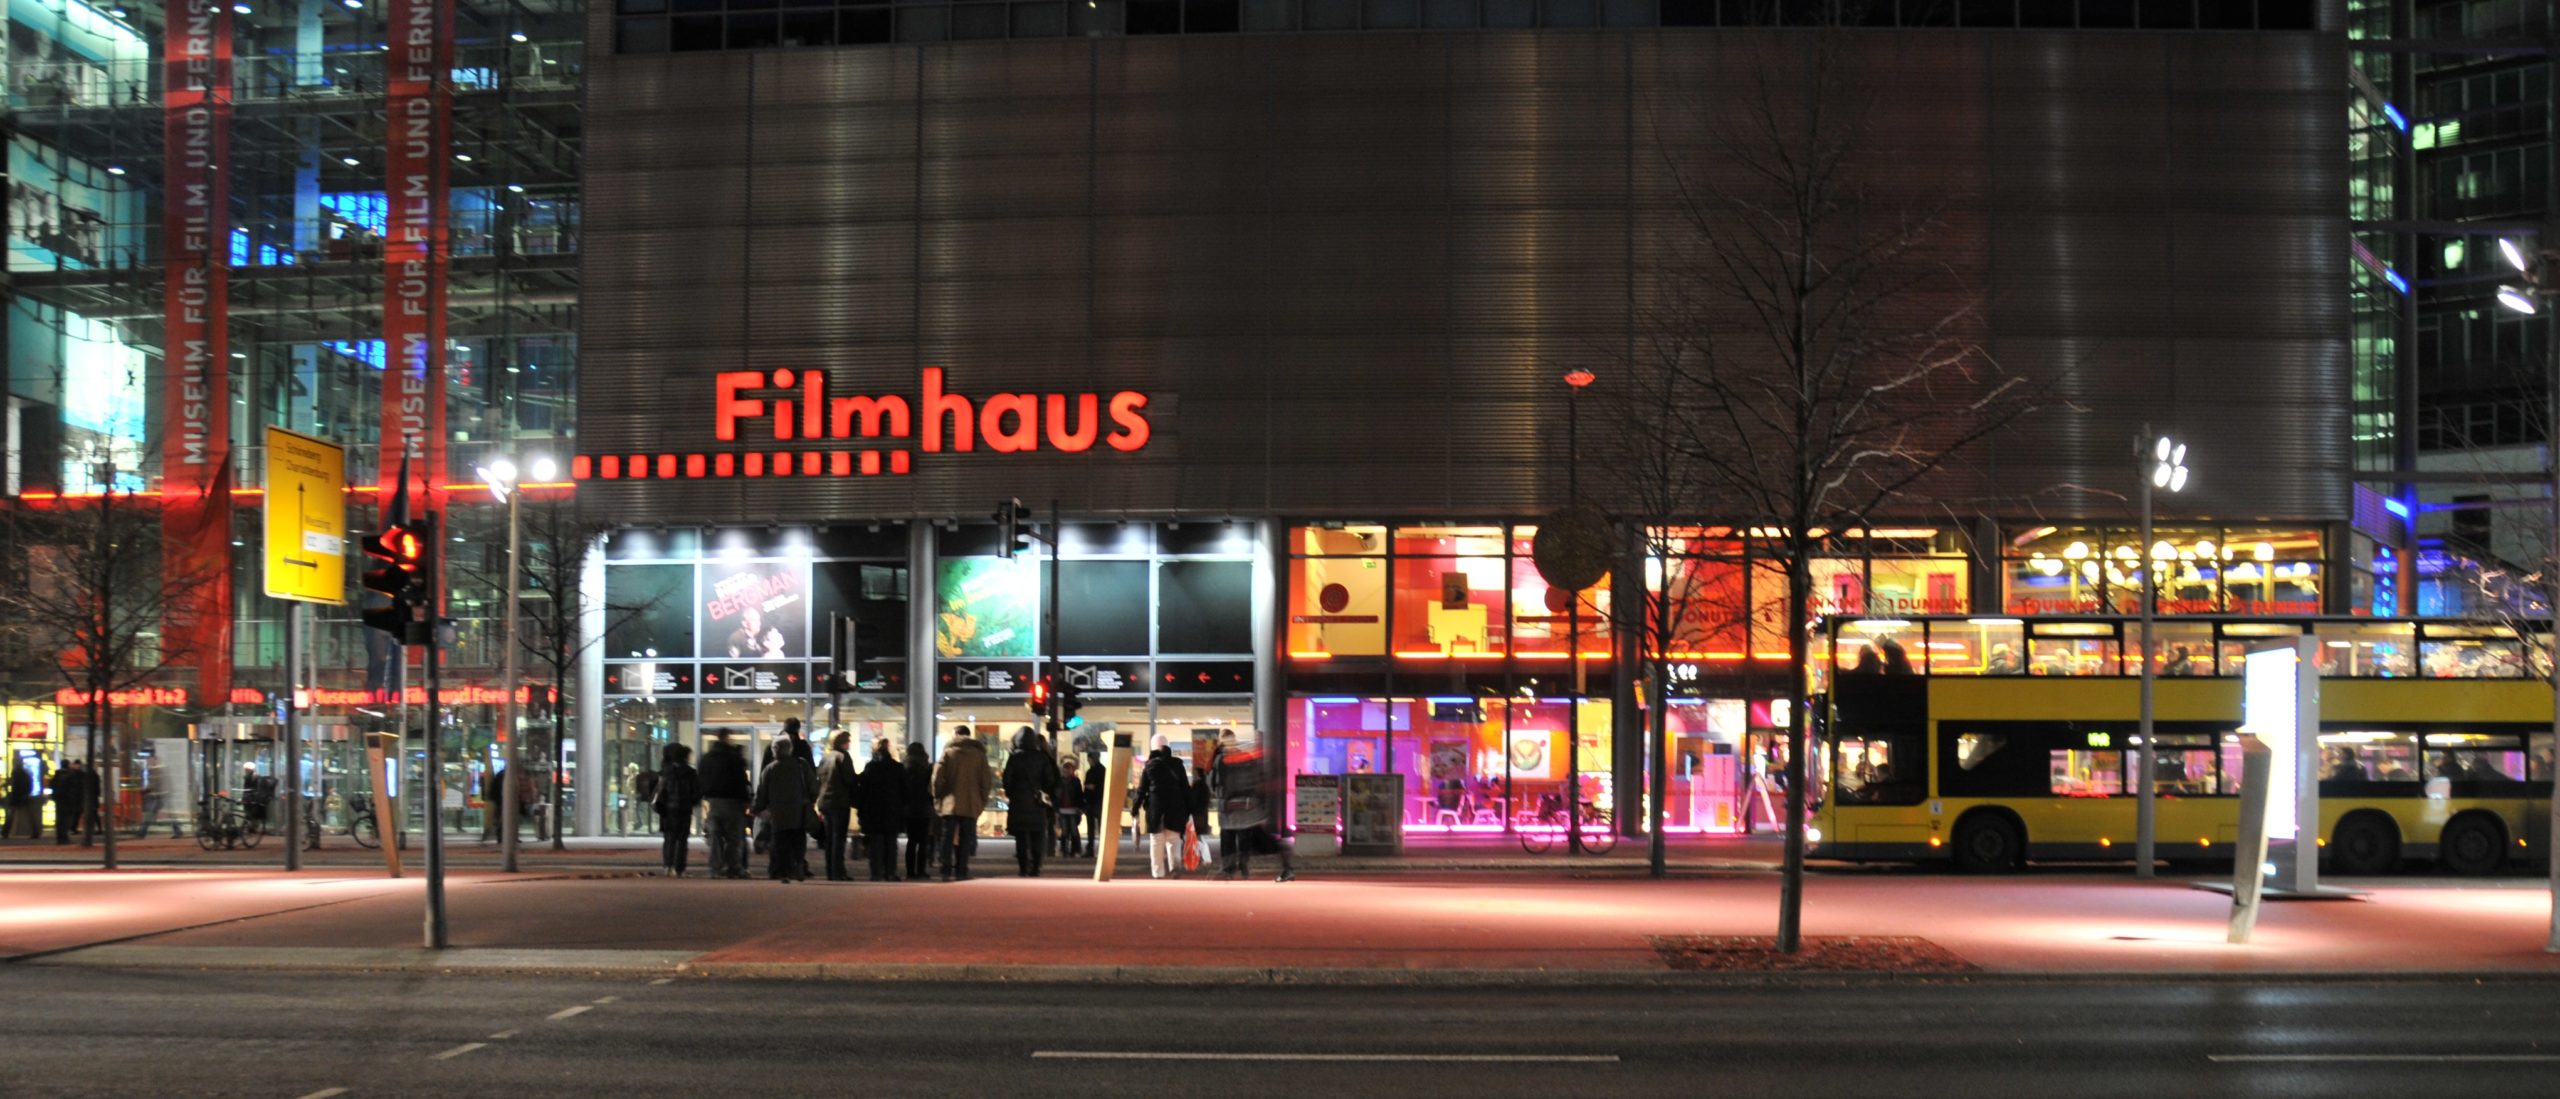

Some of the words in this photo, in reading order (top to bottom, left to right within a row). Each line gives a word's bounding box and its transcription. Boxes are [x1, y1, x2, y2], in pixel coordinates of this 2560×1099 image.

[407, 0, 433, 82] FERN
[186, 107, 210, 168] UND
[406, 97, 431, 158] UND
[185, 183, 209, 251] FILM
[403, 174, 430, 243] FILM
[179, 266, 207, 323] FÜR
[398, 260, 427, 315] FÜR
[183, 340, 208, 464] MUSEUM
[402, 332, 426, 458] MUSEUM
[715, 366, 1150, 453] Filmhaus
[706, 569, 800, 621] BERGMAN
[2026, 598, 2103, 612] DUNKIN
[155, 687, 188, 705] 1+2
[438, 685, 471, 704] und
